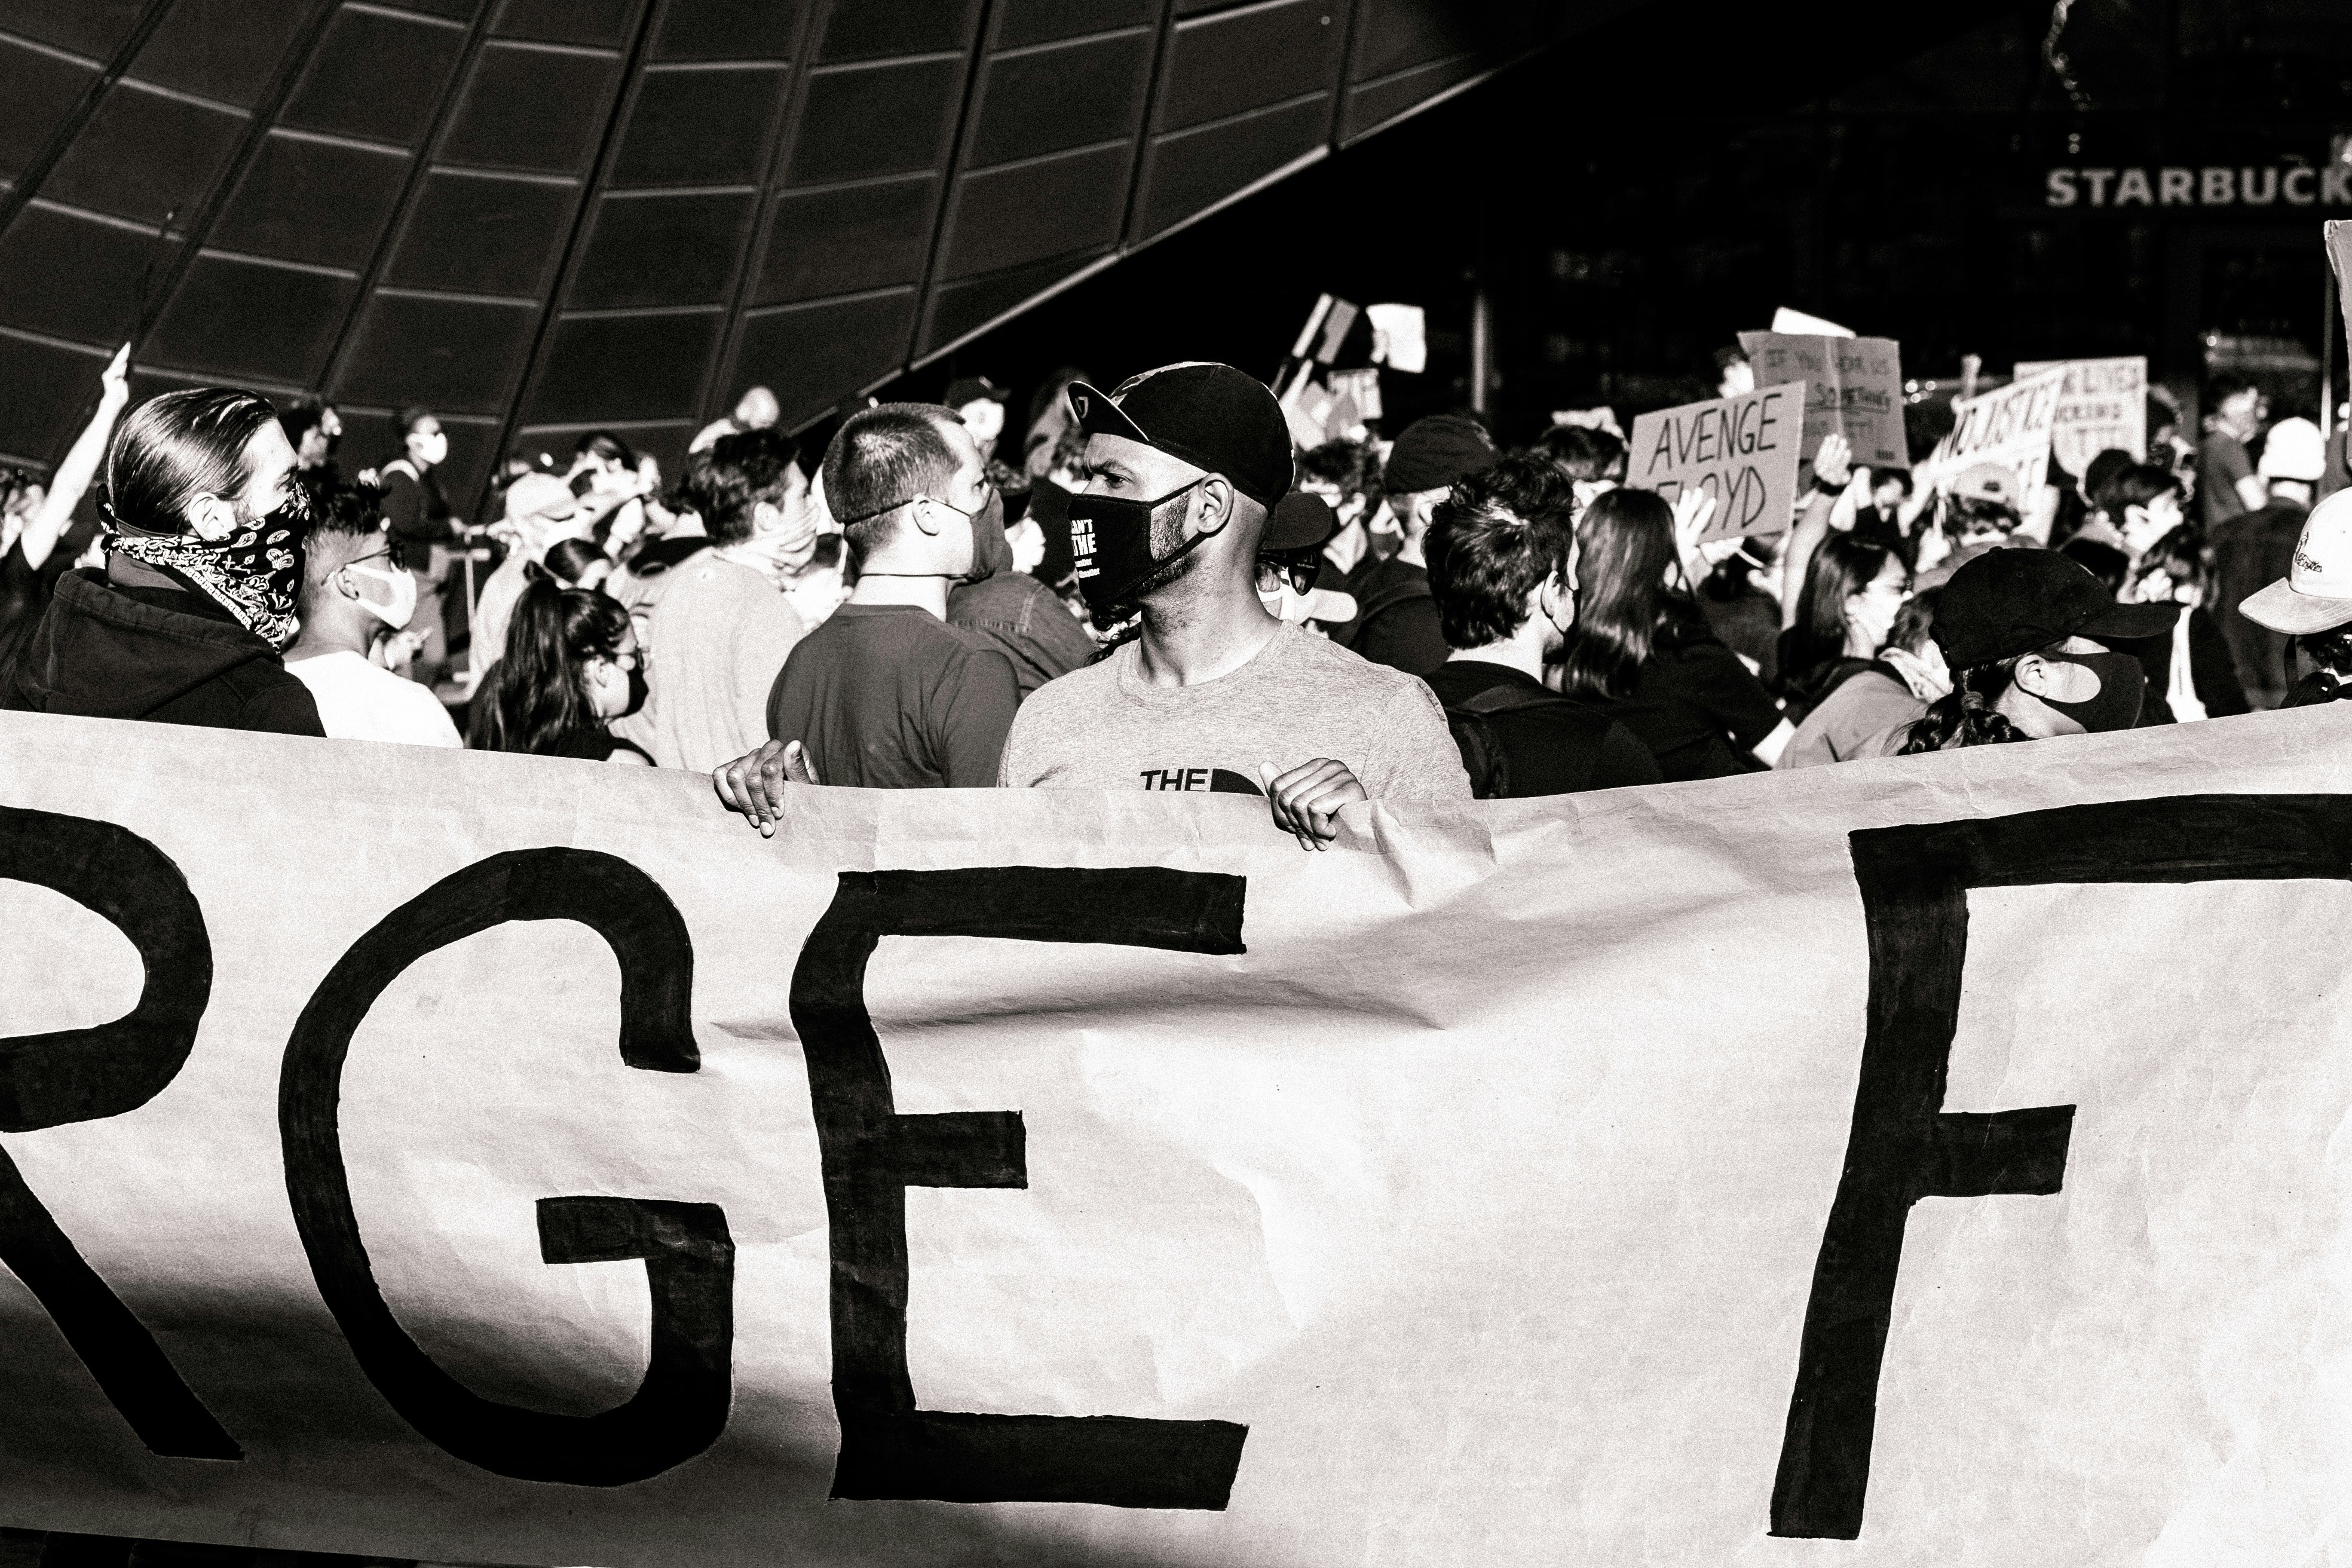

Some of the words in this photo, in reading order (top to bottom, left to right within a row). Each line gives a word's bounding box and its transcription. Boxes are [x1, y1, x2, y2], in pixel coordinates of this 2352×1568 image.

[2045, 166, 2352, 207] STARBUCK
[1647, 392, 1782, 476] AVENGE
[1071, 519, 1093, 534] AN'T
[1140, 768, 1208, 792] THE
